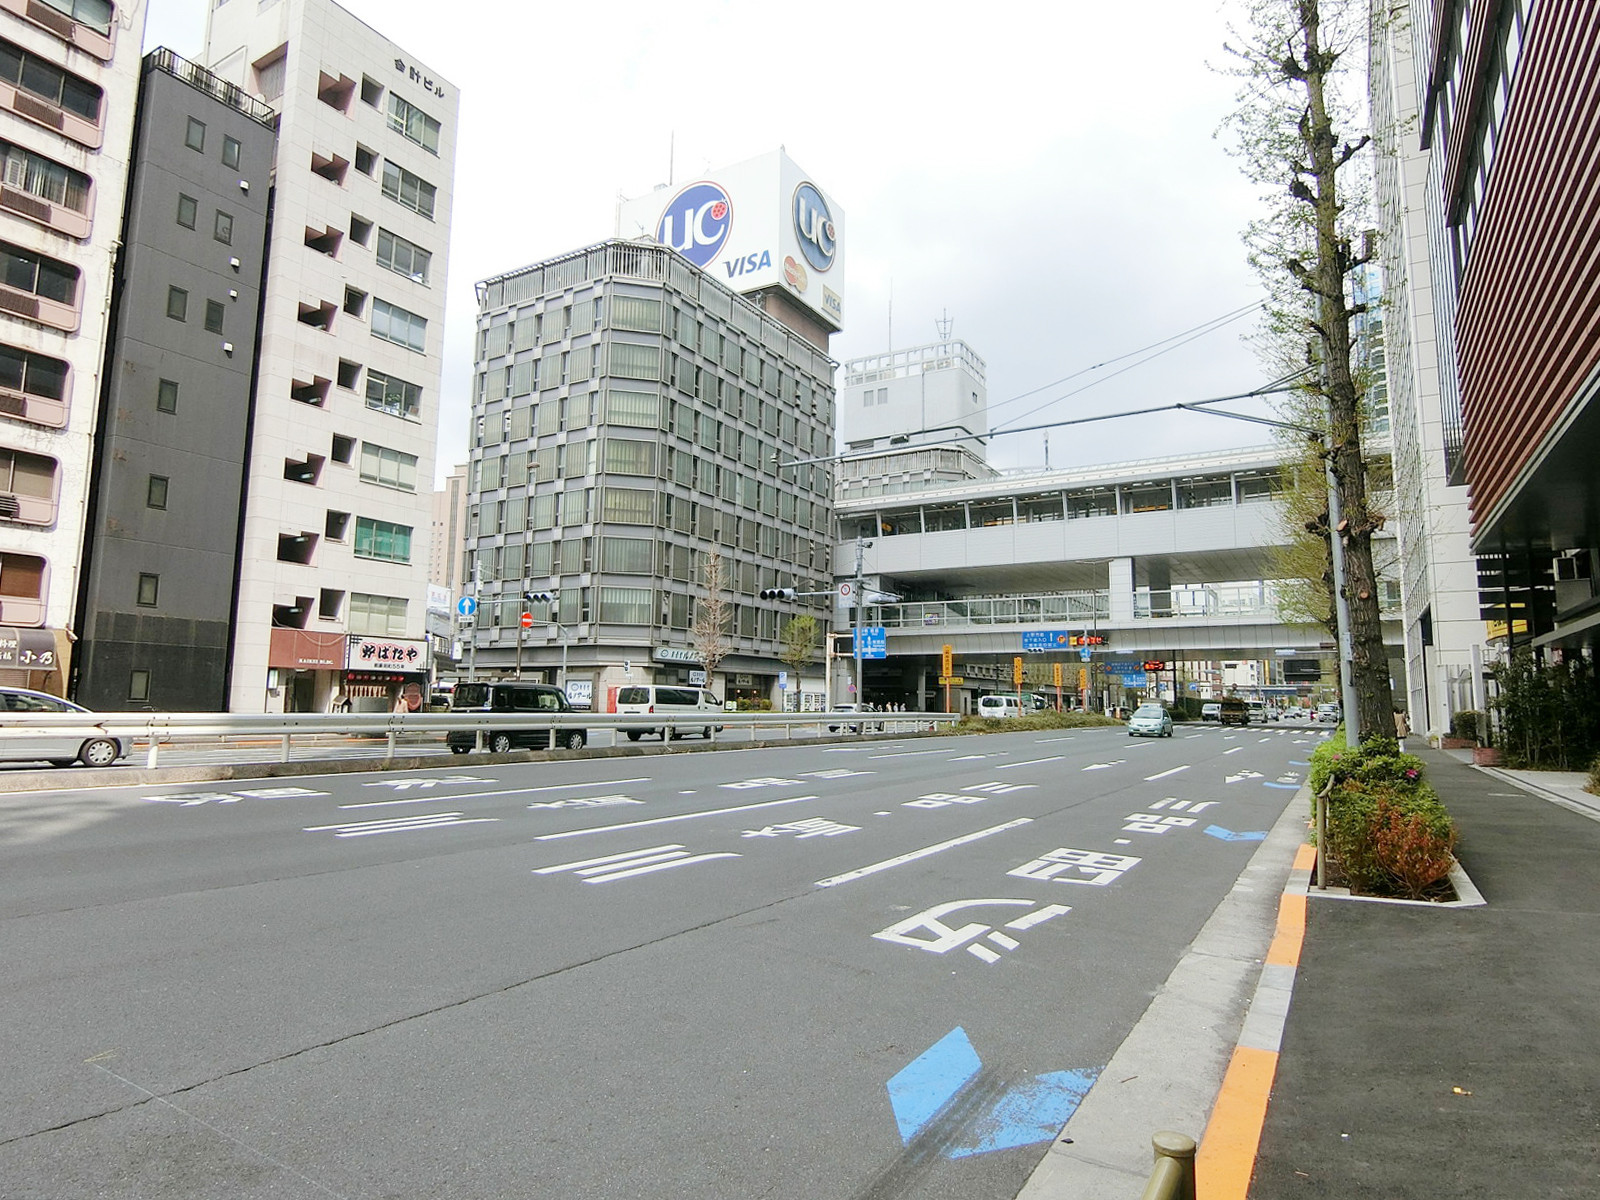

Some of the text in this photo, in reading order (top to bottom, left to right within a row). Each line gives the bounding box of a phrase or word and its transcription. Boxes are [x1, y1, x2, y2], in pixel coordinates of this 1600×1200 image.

[394, 58, 445, 98] 会計ビル
[664, 200, 727, 251] UC
[800, 195, 835, 257] UC
[723, 249, 772, 279] VISA
[824, 293, 841, 315] VISA
[362, 644, 418, 662] 炉ばたや
